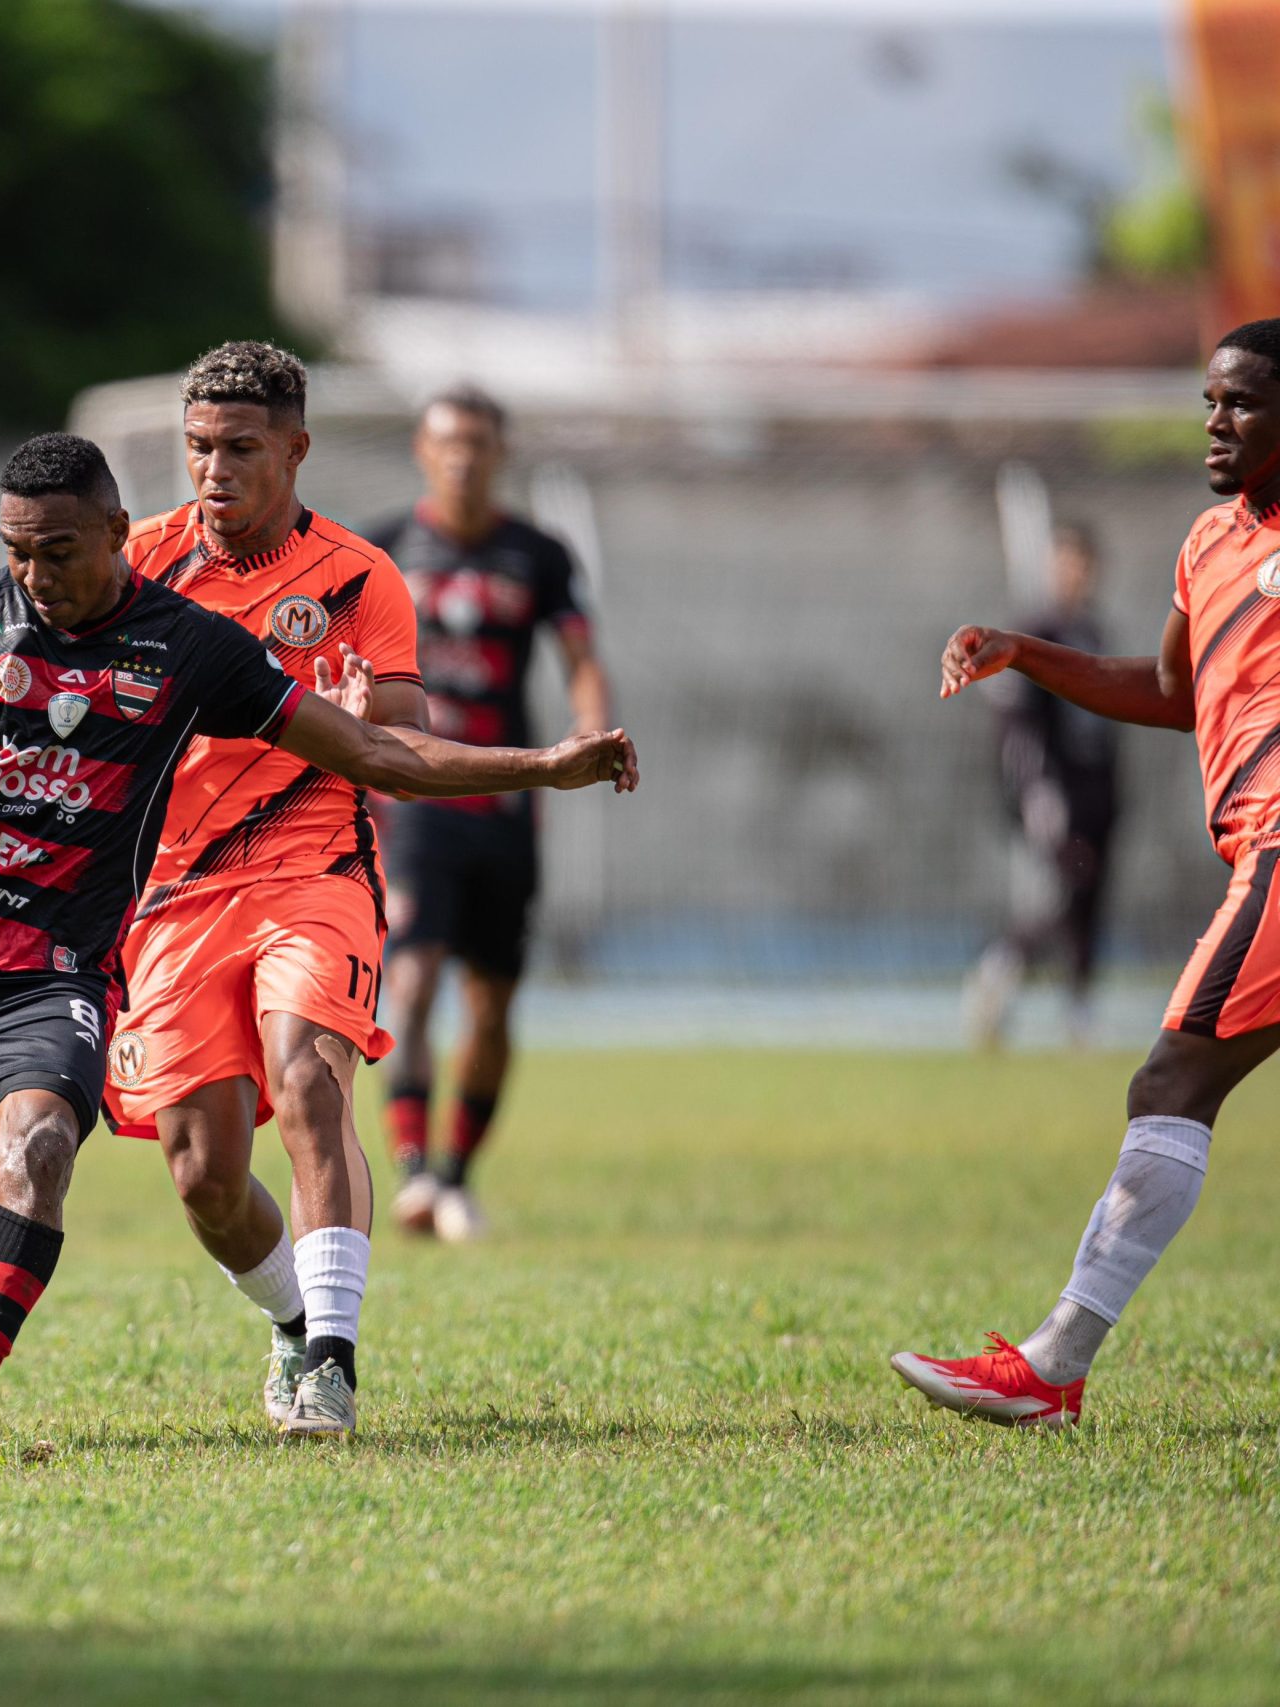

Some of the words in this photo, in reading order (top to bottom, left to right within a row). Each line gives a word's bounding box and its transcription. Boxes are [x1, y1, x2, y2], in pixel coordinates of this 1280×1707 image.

[286, 606, 311, 634] M
[345, 953, 374, 1010] 17
[68, 996, 100, 1041] 8
[118, 1043, 138, 1075] M
